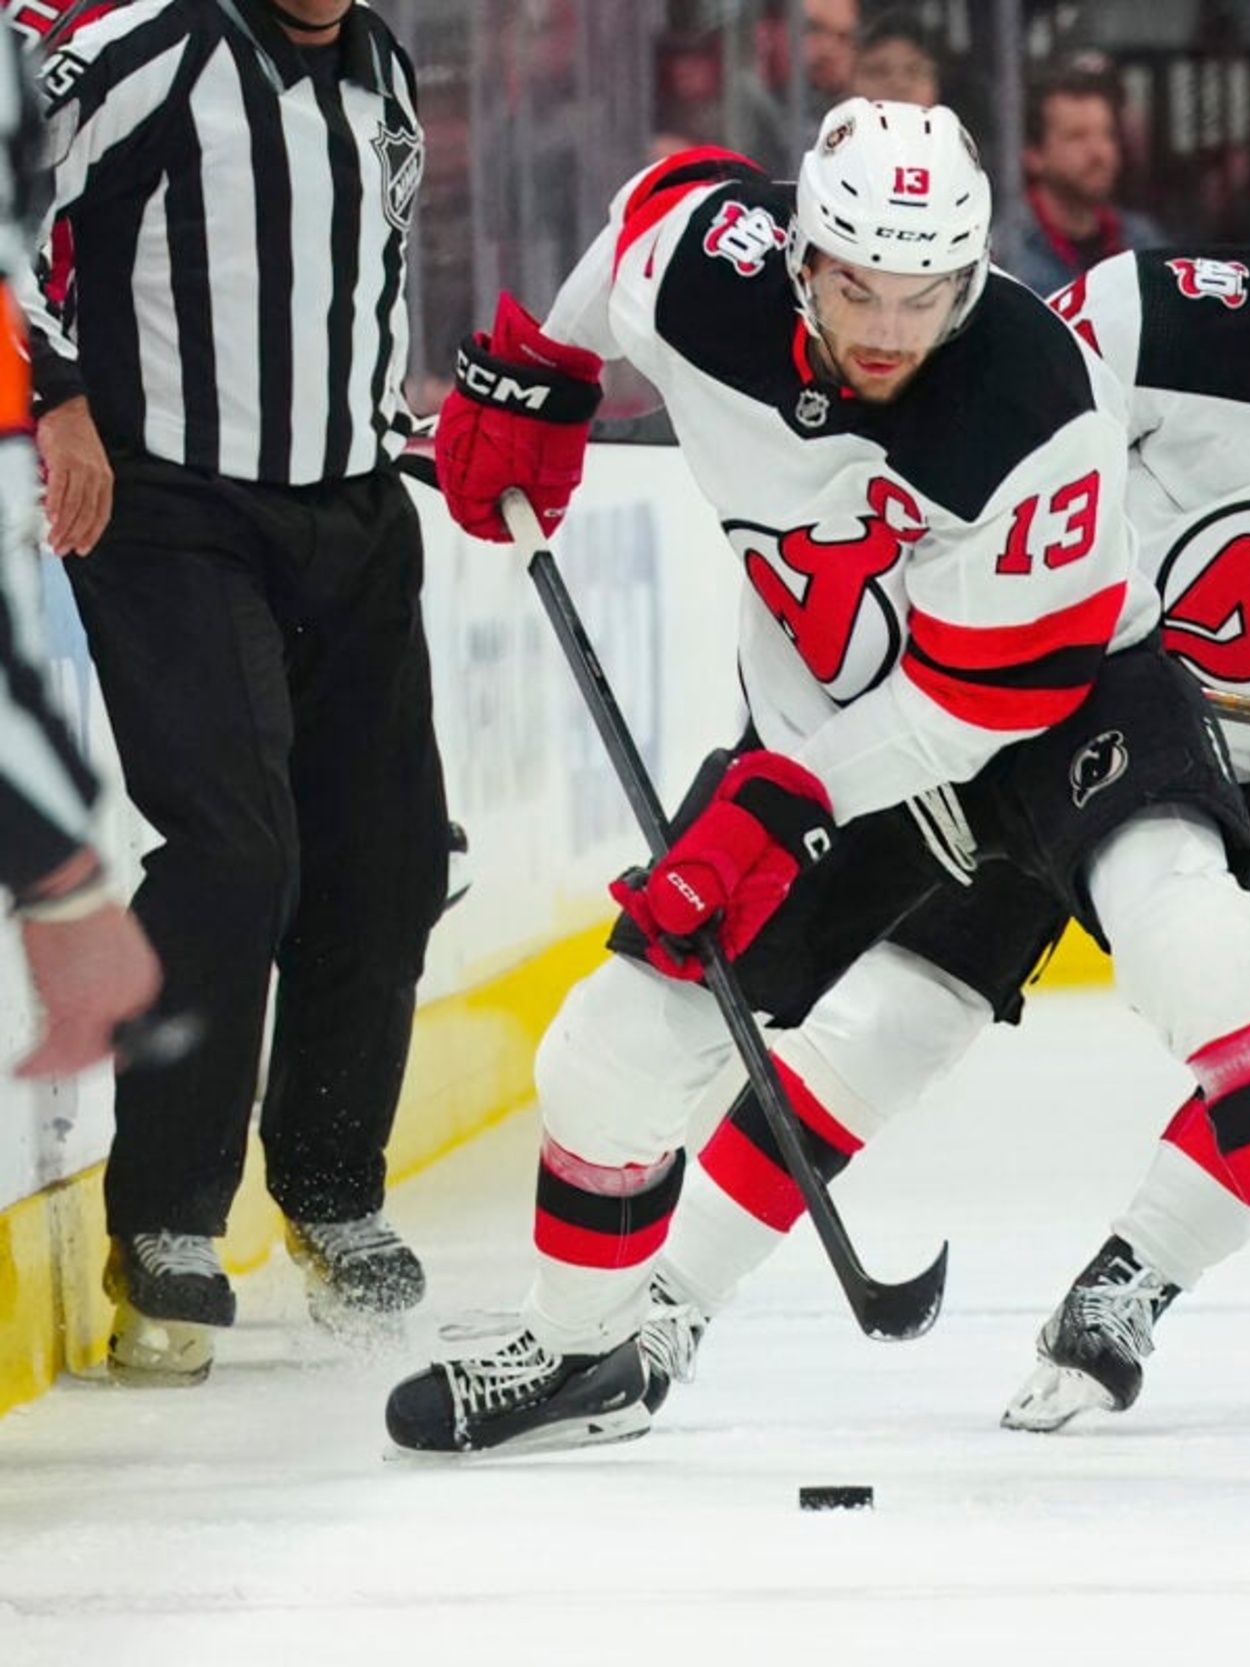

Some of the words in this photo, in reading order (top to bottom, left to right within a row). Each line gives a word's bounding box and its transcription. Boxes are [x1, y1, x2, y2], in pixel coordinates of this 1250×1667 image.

[892, 166, 931, 195] 13
[874, 226, 938, 243] CCM
[456, 349, 551, 410] CCM
[867, 476, 931, 543] C
[996, 469, 1100, 575] 13
[667, 872, 705, 912] CCM
